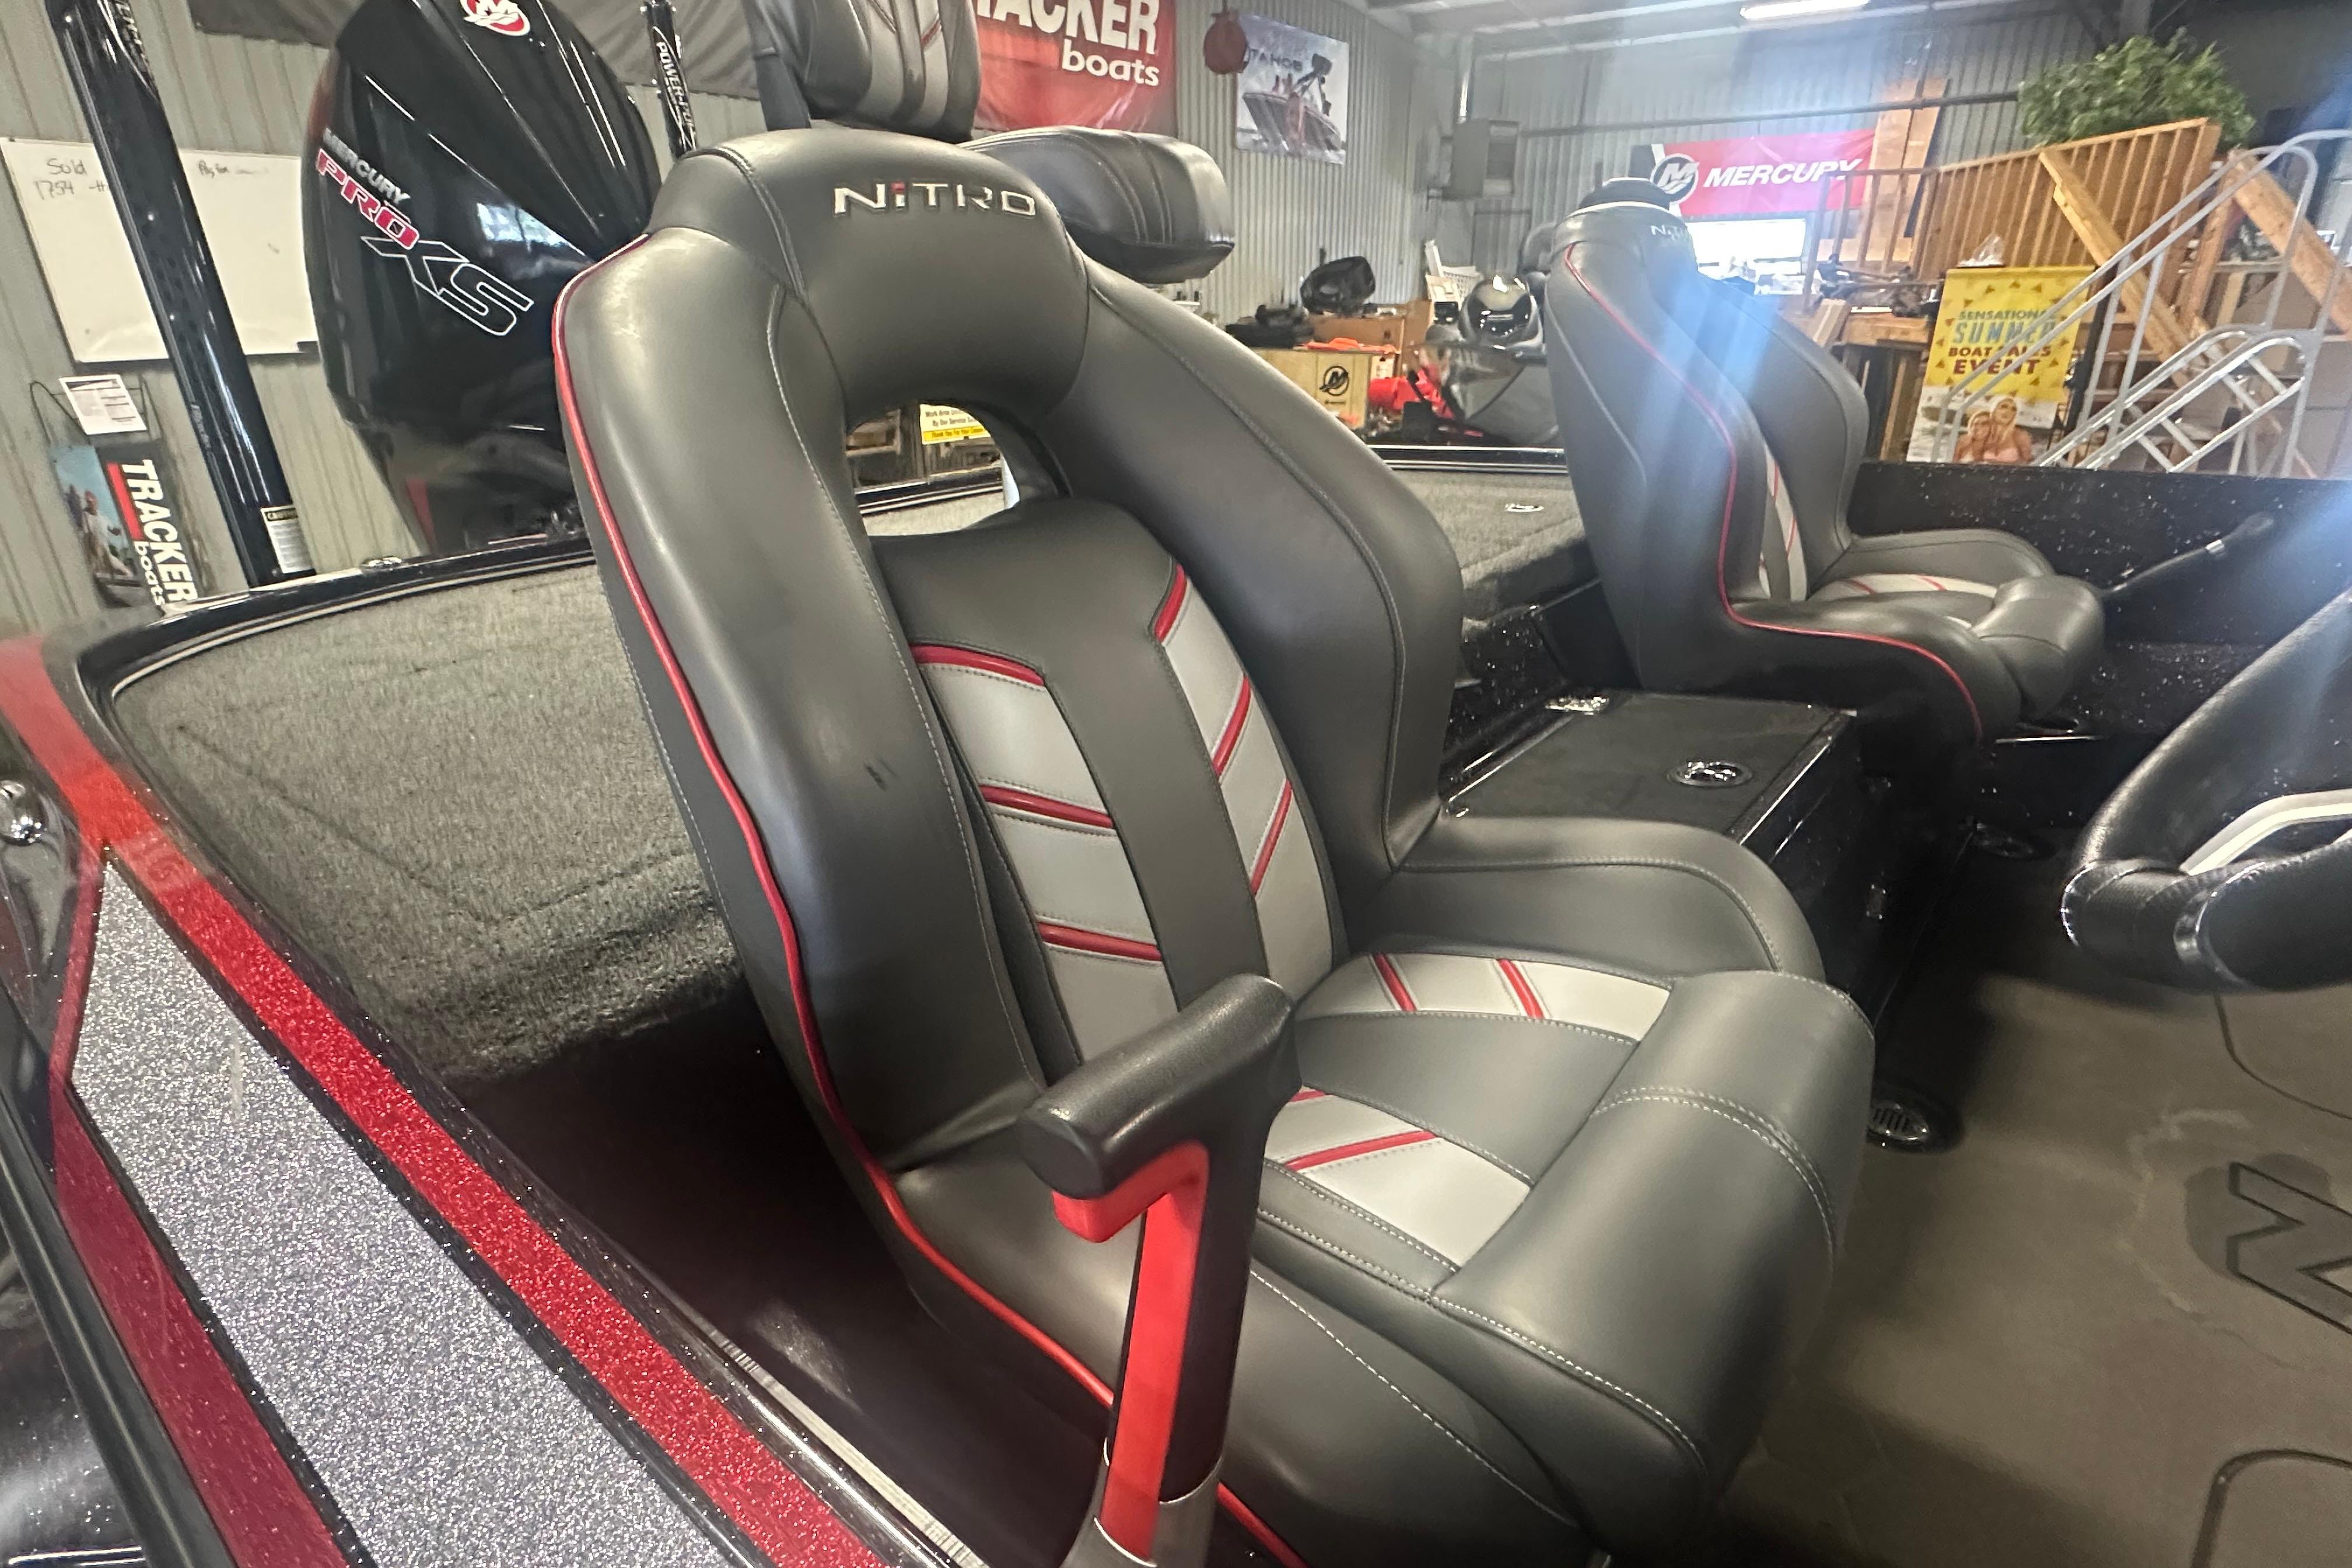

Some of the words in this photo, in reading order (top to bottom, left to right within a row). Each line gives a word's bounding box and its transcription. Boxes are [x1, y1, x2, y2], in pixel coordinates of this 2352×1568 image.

[1062, 38, 1160, 86] boats
[47, 158, 88, 176] Sold
[323, 126, 411, 206] MERCURY
[1703, 159, 1863, 188] MERCURY
[315, 148, 420, 250] PRO
[360, 235, 534, 336] XS
[1948, 346, 1992, 357] BOAT
[1996, 345, 2051, 357] ALS
[1953, 359, 2040, 374] EVENT
[121, 459, 198, 601] TRACKER
[133, 541, 166, 606] boats
